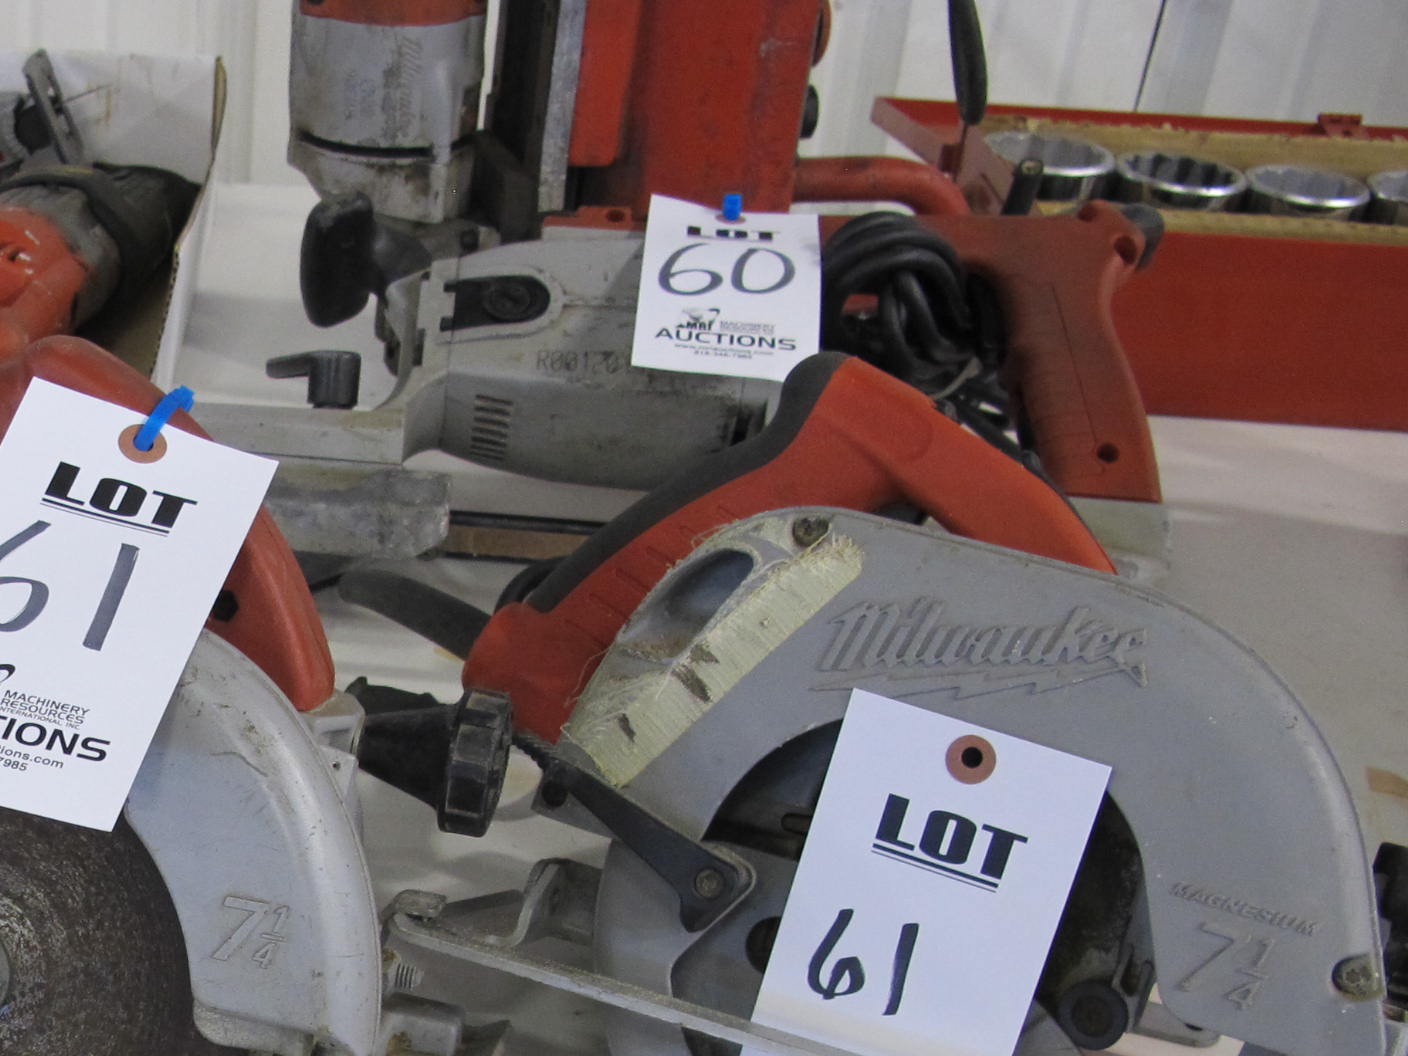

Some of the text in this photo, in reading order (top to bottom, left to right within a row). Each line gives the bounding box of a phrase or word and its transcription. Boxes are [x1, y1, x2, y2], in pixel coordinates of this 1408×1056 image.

[687, 226, 780, 241] LOT
[658, 242, 795, 296] 60
[655, 327, 796, 351] AUCTIONS
[44, 461, 198, 529] LOT
[814, 597, 1150, 690] Milwaukee
[0, 698, 85, 725] RESOURCES
[3, 690, 91, 716] MACHINERY
[875, 793, 1029, 880] LOT
[807, 908, 920, 1016] 61
